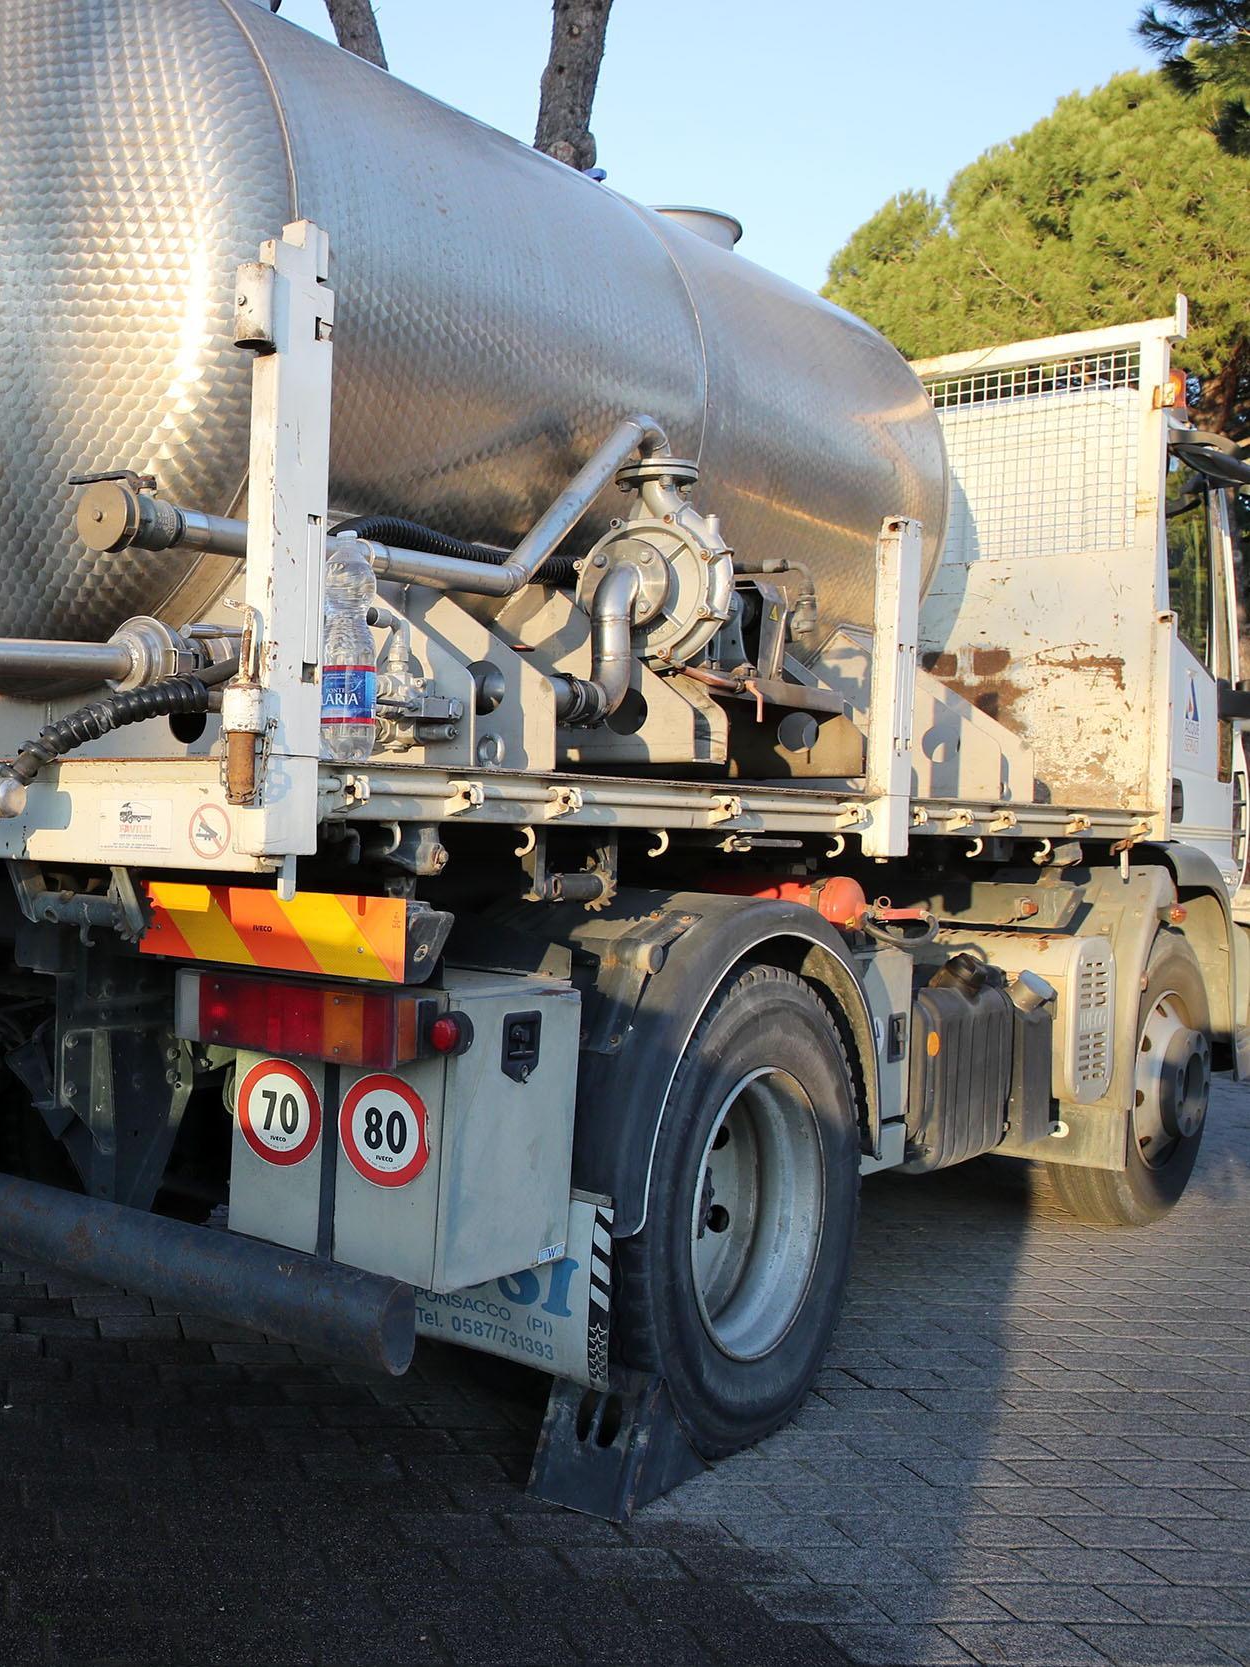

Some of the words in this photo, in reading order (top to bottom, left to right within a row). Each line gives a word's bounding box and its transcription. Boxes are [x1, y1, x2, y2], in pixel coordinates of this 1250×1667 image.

[253, 924, 273, 933] IVECO
[261, 1089, 299, 1135] 70
[363, 1106, 407, 1155] 80
[269, 1134, 287, 1143] IVECO
[375, 1154, 394, 1163] IVECO
[413, 1286, 511, 1321] PONSACCO
[526, 1314, 553, 1337] (PI)
[415, 1307, 443, 1329] Tel.
[451, 1316, 555, 1361] 0587/731393
